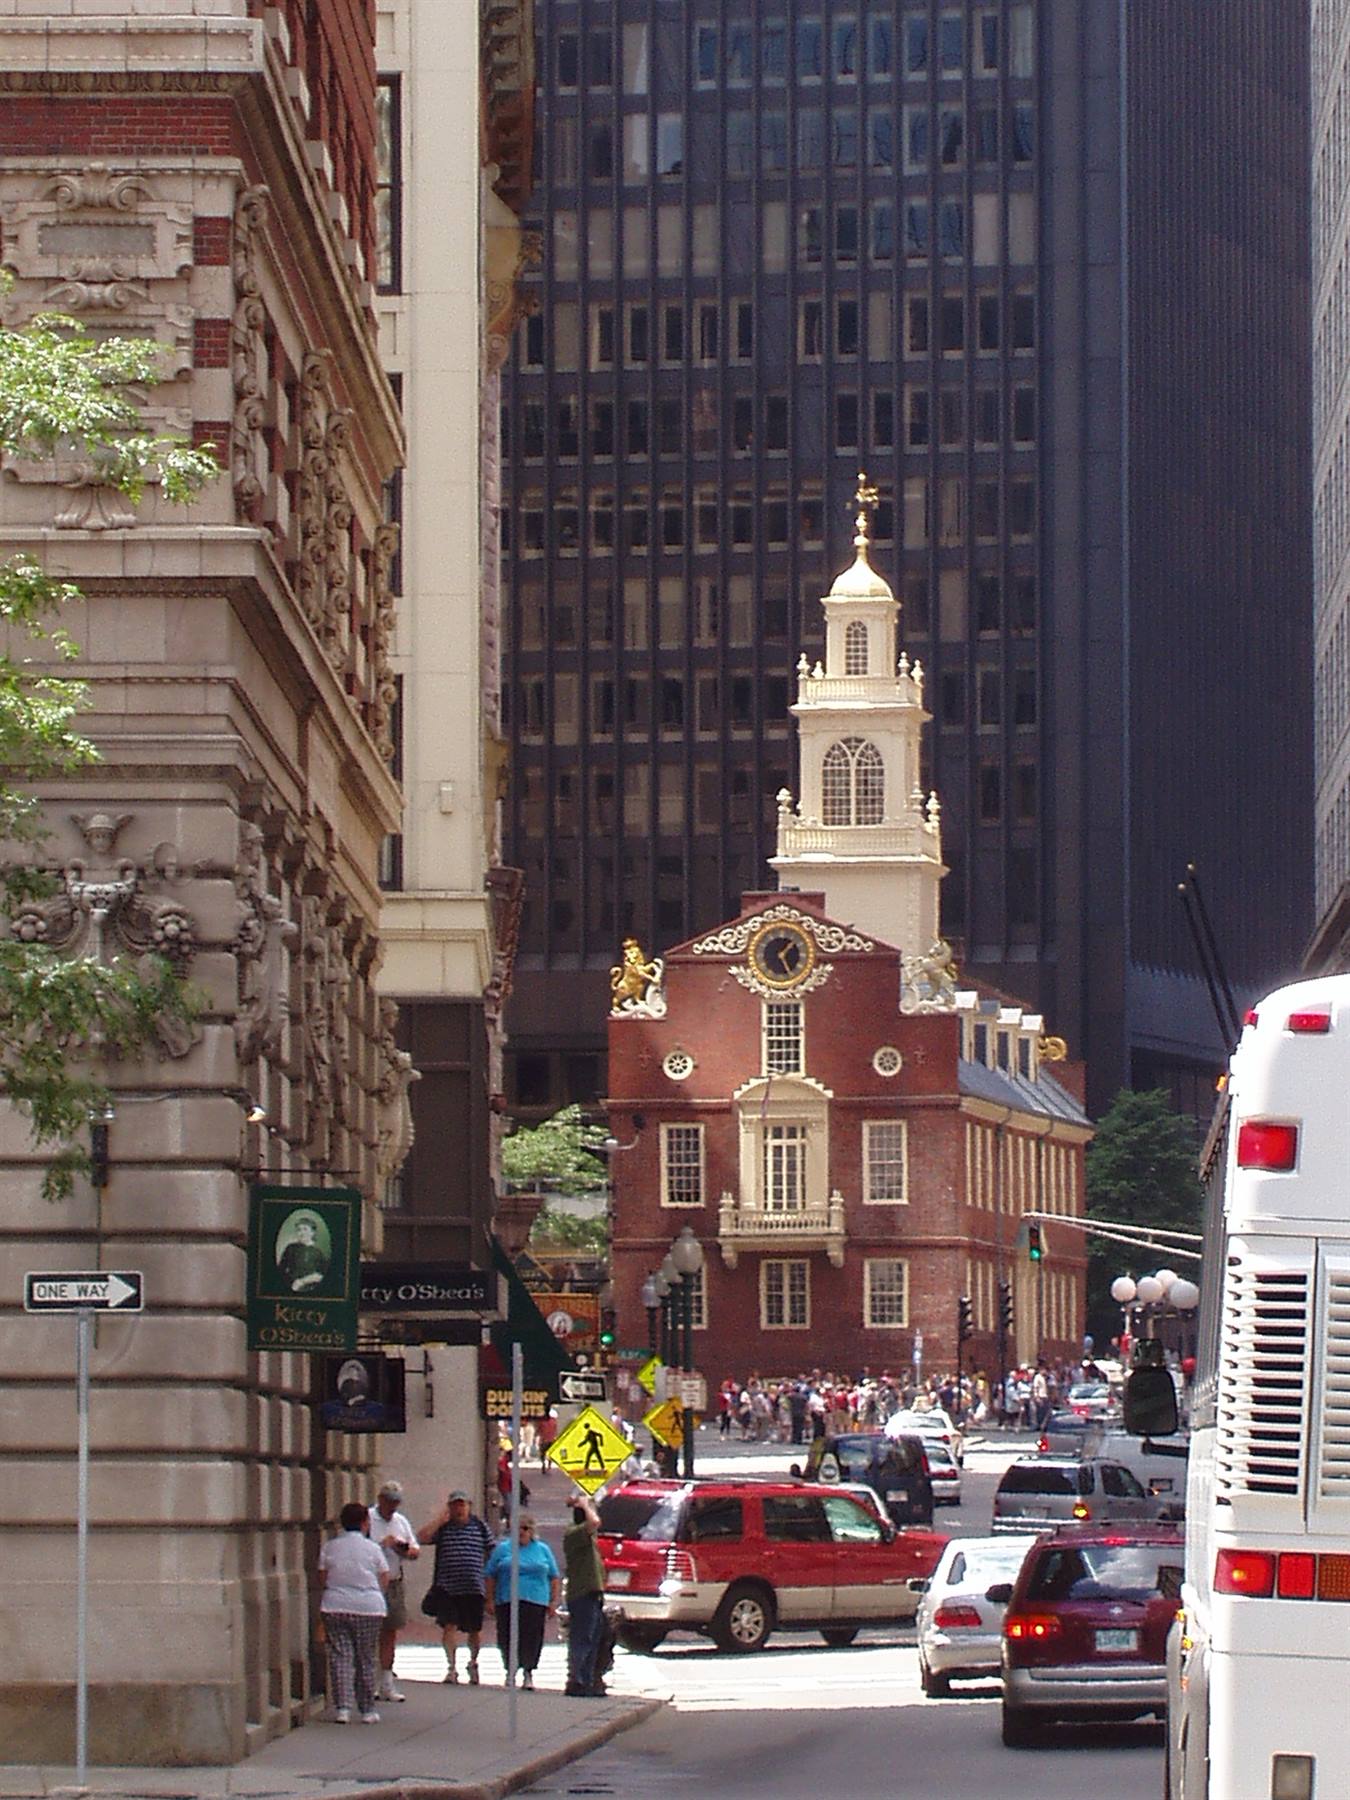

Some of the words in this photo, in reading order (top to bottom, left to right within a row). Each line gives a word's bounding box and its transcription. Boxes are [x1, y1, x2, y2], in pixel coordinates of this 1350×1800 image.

[37, 1284, 68, 1298] ONE
[76, 1284, 108, 1297] WAY
[361, 1286, 392, 1304] tty
[398, 1283, 485, 1300] O'Shea's
[275, 1303, 327, 1326] Kitty
